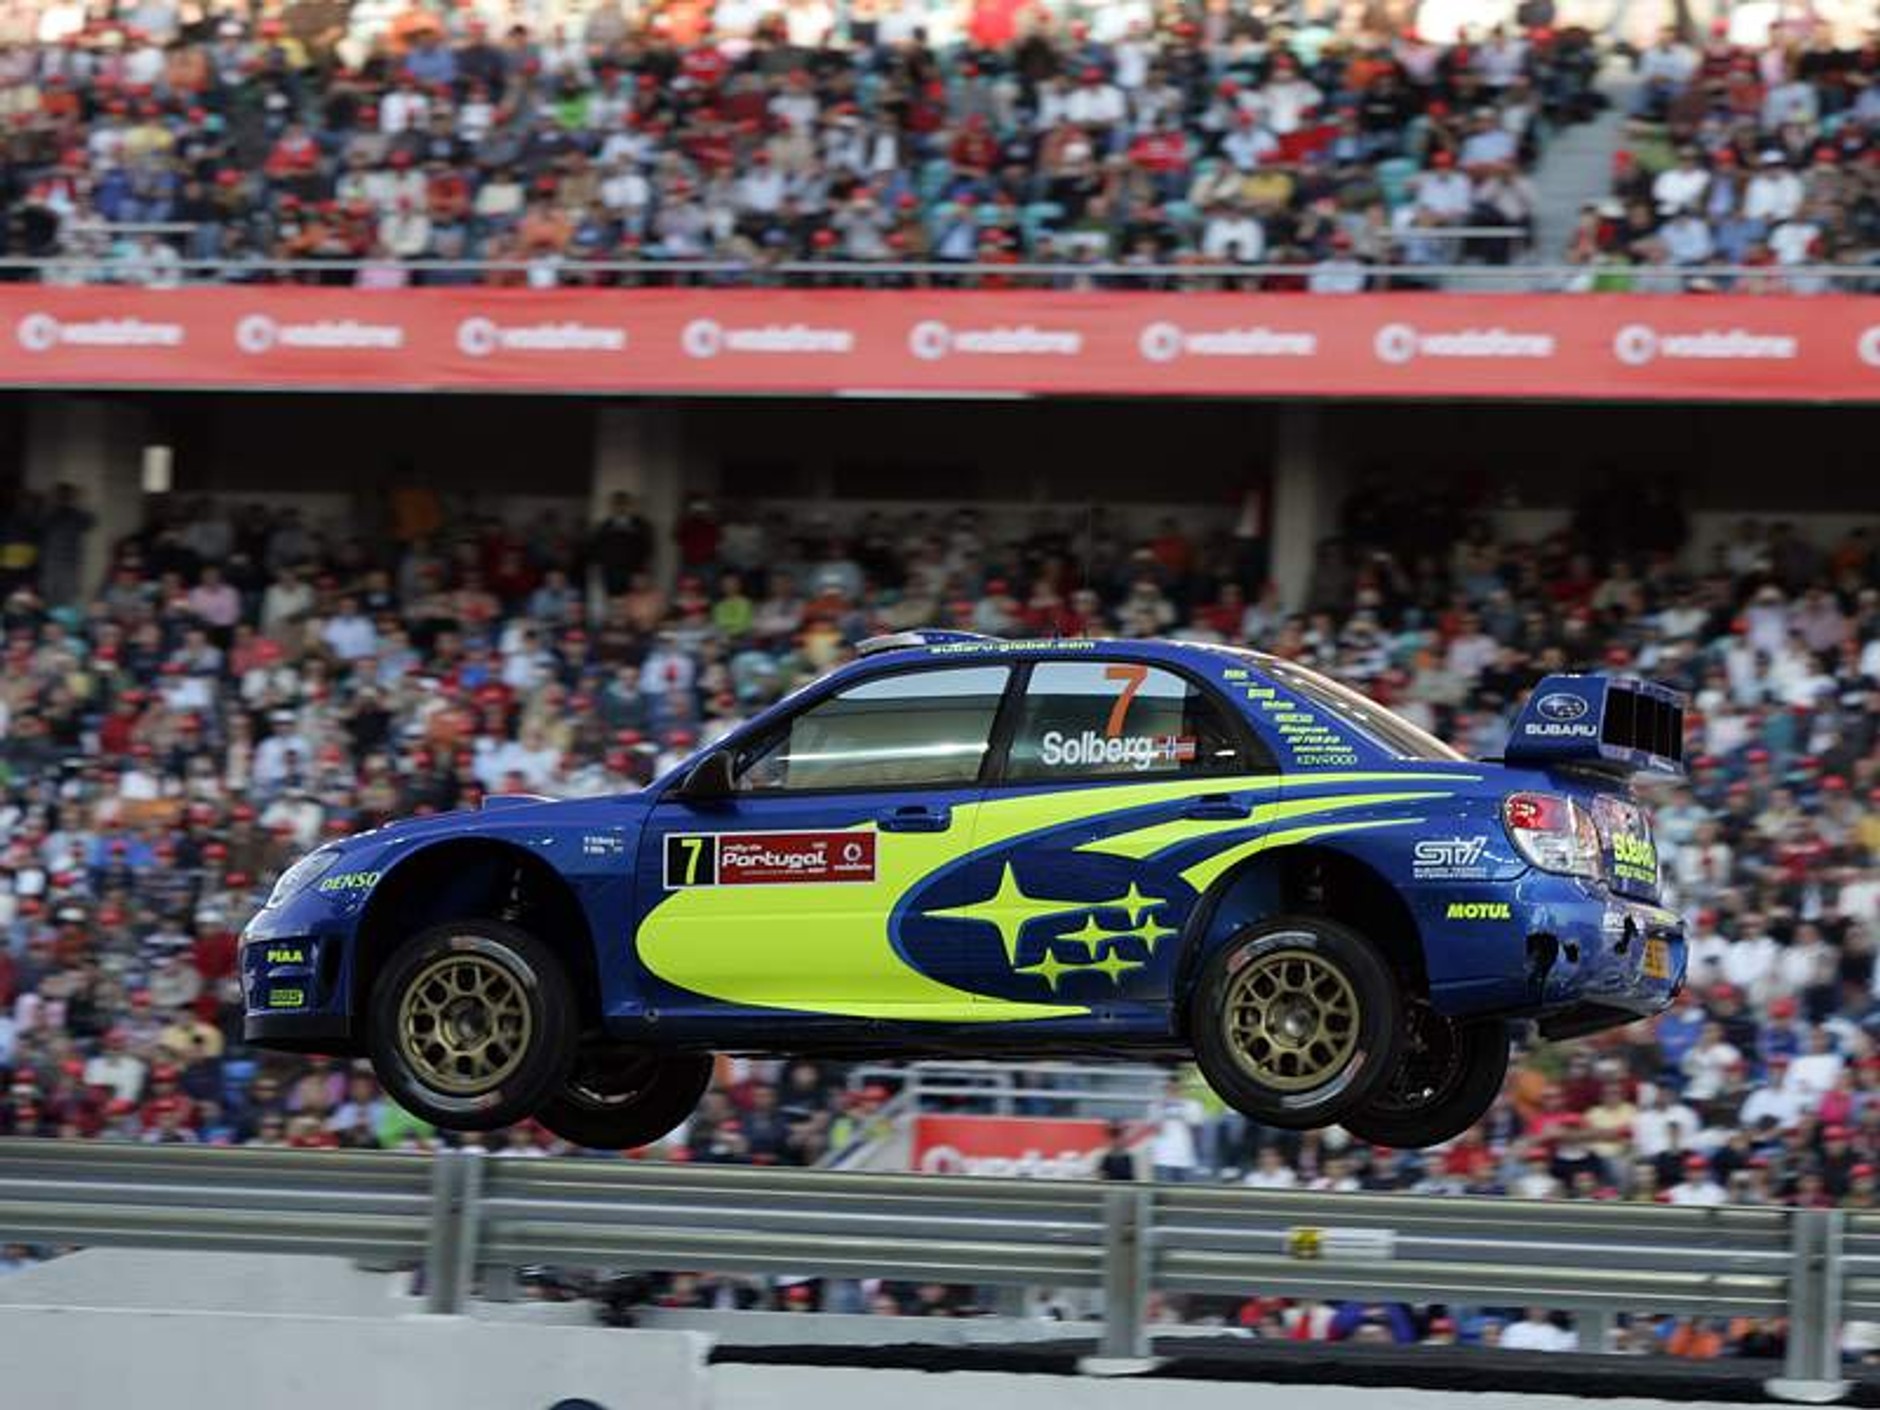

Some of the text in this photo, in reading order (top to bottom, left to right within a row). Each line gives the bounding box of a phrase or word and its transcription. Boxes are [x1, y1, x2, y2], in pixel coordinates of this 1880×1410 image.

[1105, 666, 1148, 737] 7
[1525, 724, 1597, 737] SUBARU
[1041, 731, 1151, 771] Solberg
[681, 839, 702, 885] 7
[722, 850, 827, 868] Portugal
[320, 872, 379, 891] DENSO
[1447, 902, 1511, 919] MOTUL
[266, 950, 303, 963] PIAA
